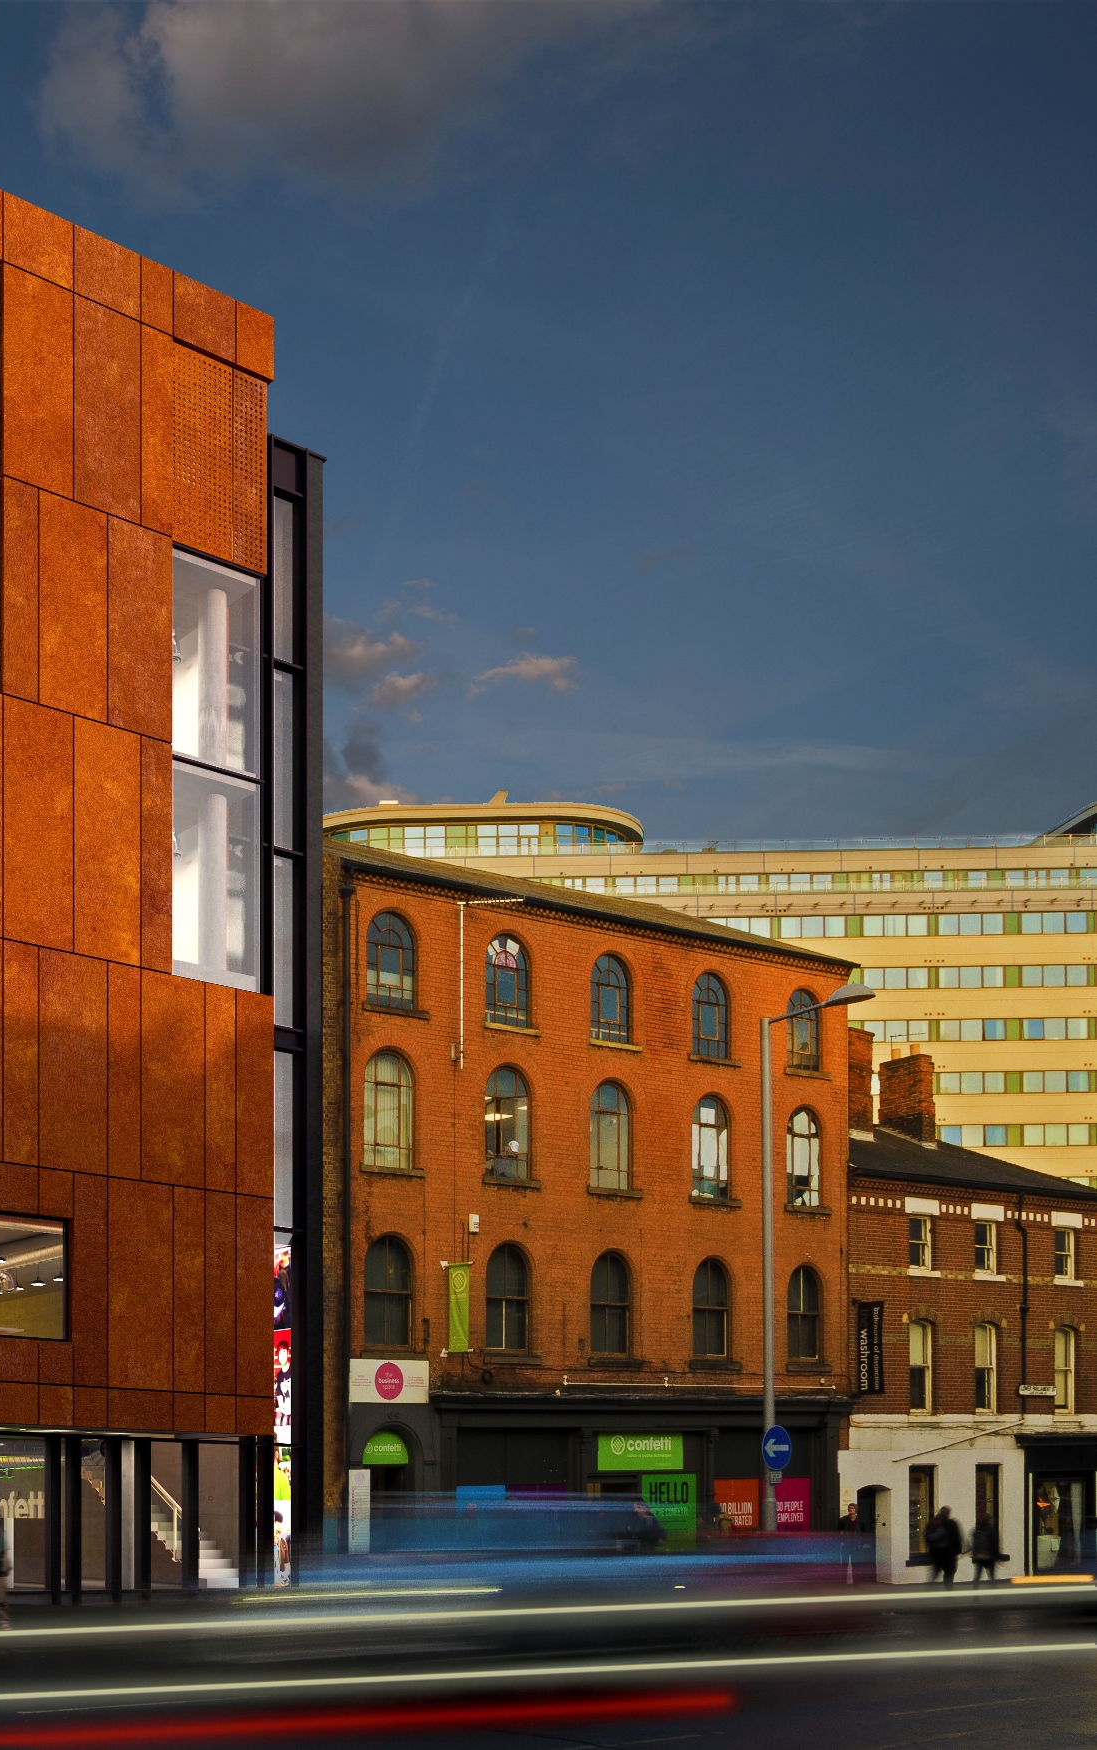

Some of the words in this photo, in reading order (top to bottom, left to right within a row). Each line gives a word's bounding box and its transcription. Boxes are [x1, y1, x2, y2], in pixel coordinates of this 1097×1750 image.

[873, 1345, 880, 1353] of
[860, 1329, 870, 1391] washroom
[374, 1444, 402, 1452] confetti
[626, 1437, 672, 1451] confetti
[649, 1481, 689, 1504] HELLO
[727, 1502, 753, 1514] BILLION
[784, 1501, 804, 1511] PEOPLE
[777, 1513, 804, 1523] EMPLOYED
